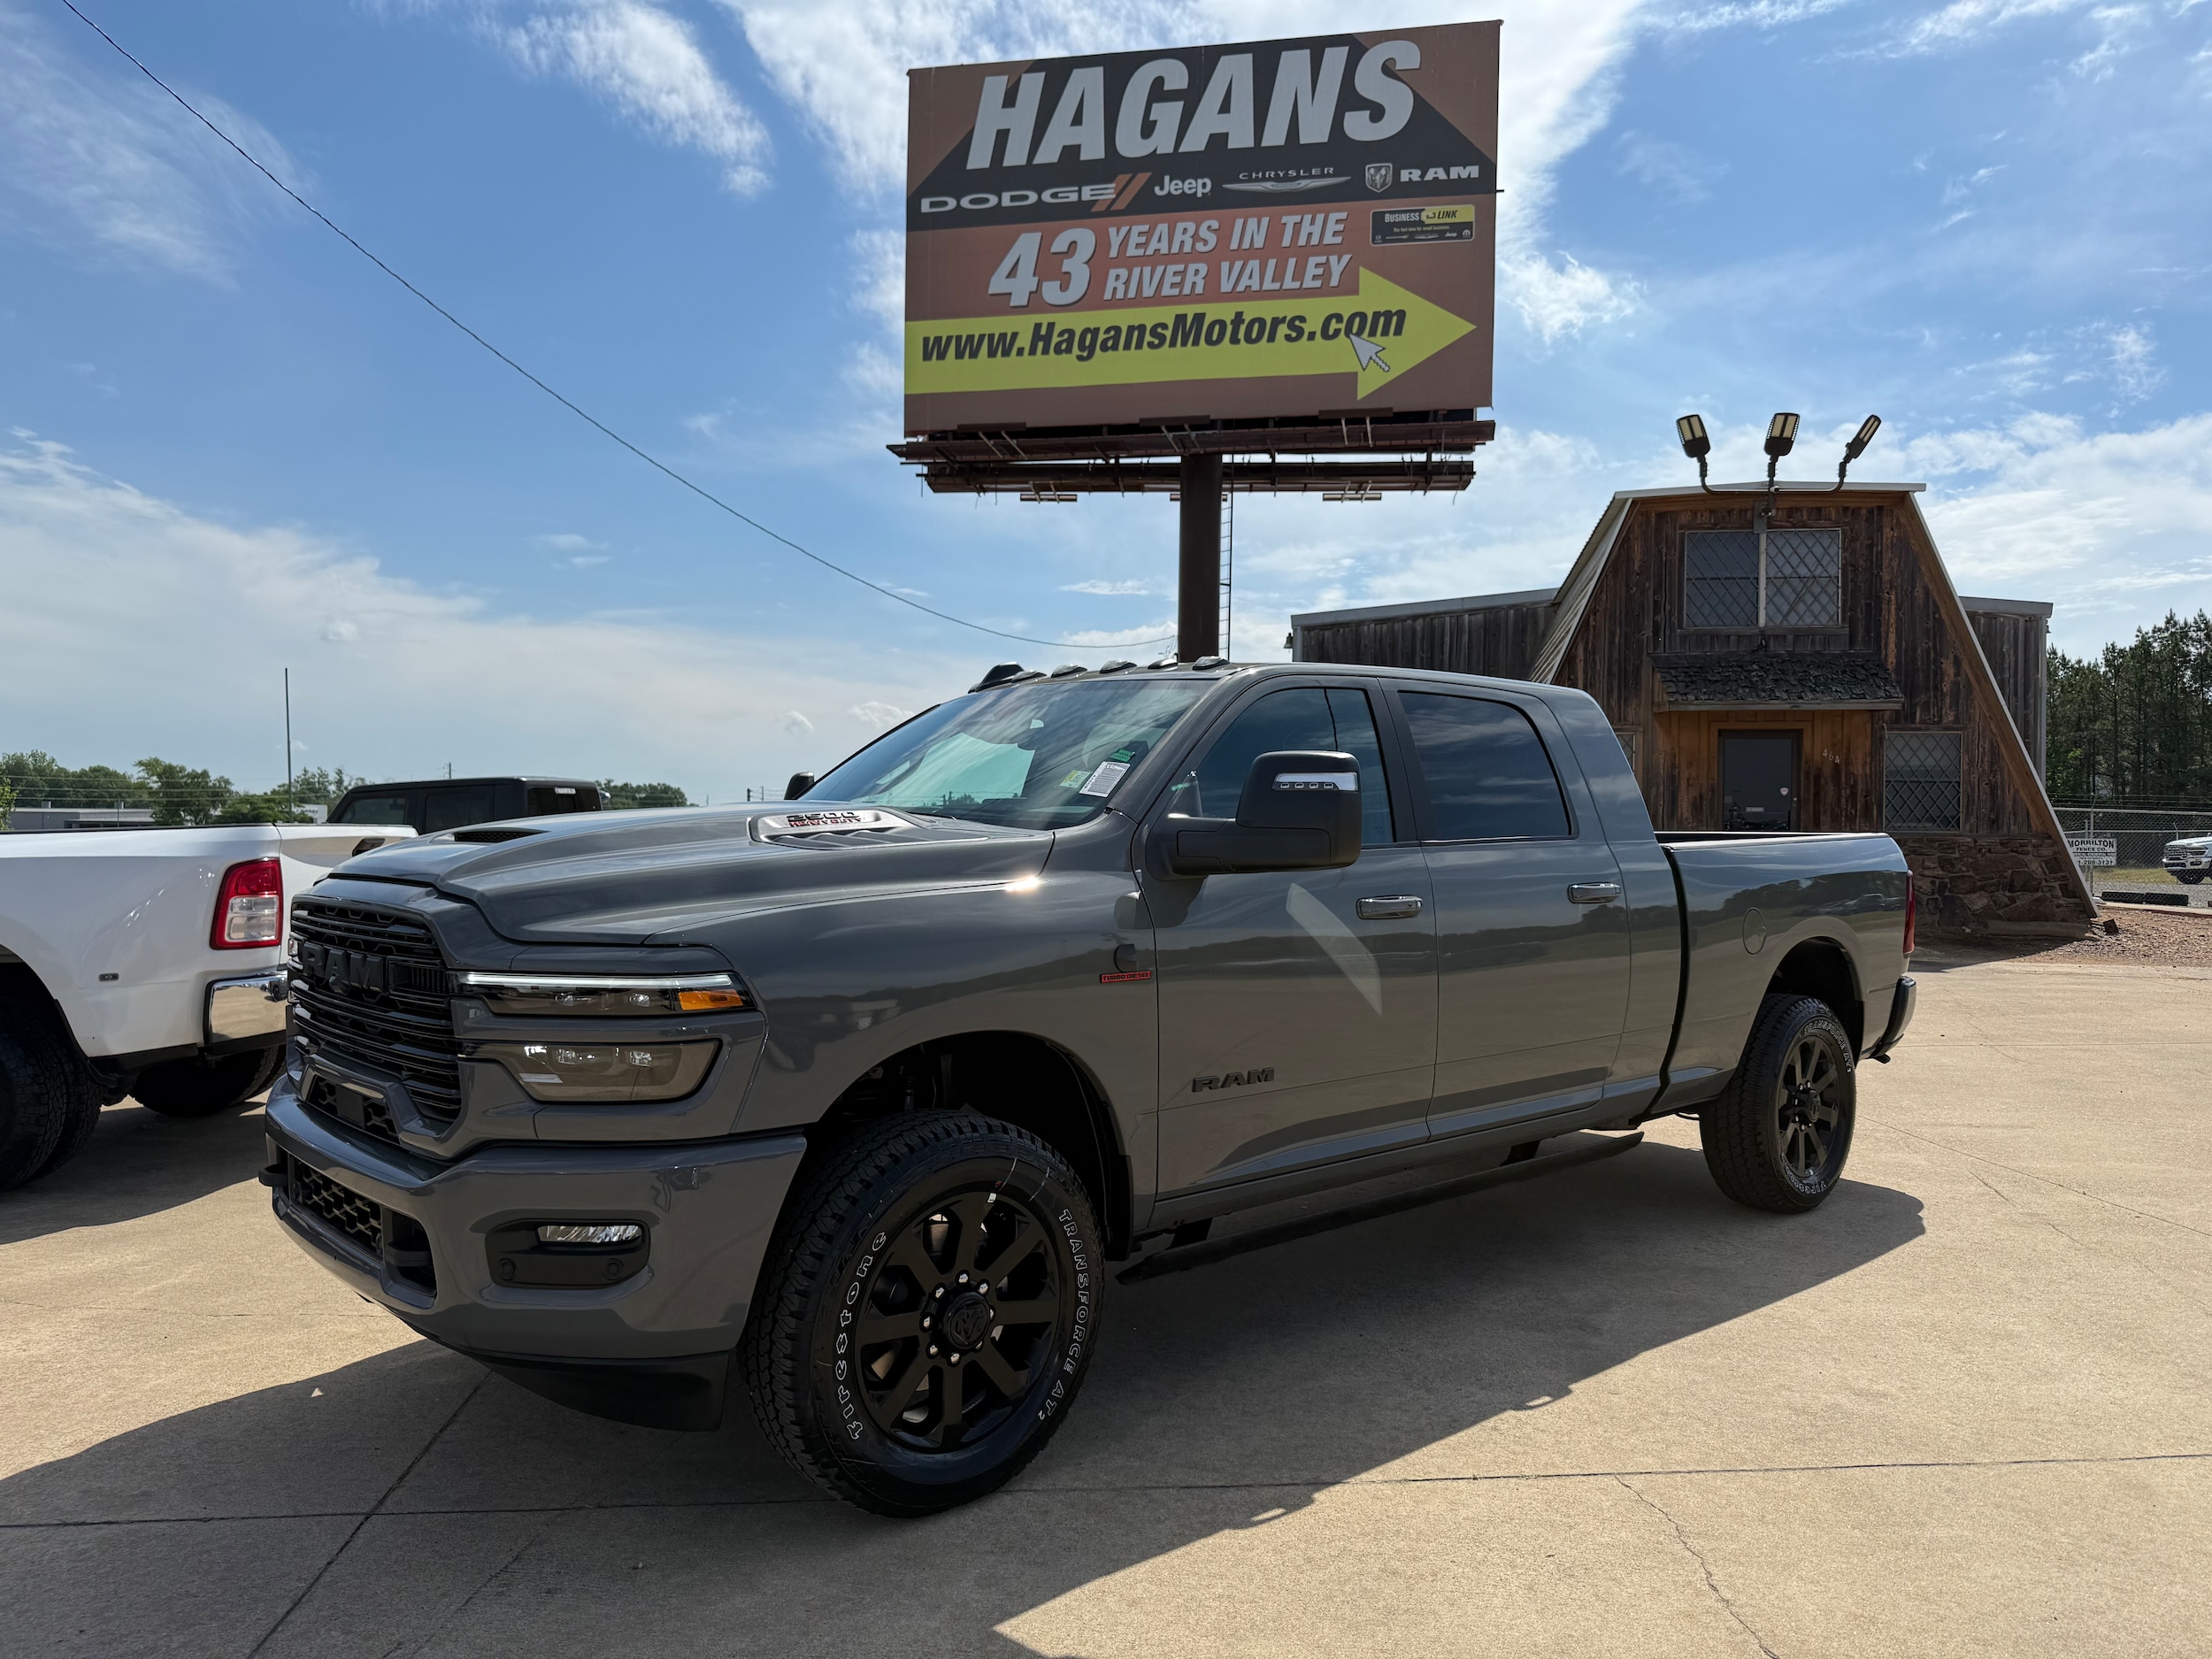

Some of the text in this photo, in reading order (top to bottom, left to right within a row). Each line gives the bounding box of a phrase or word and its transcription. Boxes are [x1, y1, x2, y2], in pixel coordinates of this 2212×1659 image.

[965, 40, 1422, 171] HAGANS
[1154, 175, 1211, 197] Jeep
[1239, 166, 1334, 180] CHRYSLER
[1400, 165, 1479, 182] RAM
[920, 182, 1116, 213] DODGE
[1384, 210, 1458, 223] BUSINESS LINK
[1108, 211, 1348, 258] YEARS IN THE
[987, 227, 1097, 308] 43
[1103, 254, 1352, 301] RIVER VALLEY
[922, 309, 1407, 363] www.HagansMotors.com
[302, 941, 384, 994] RAM
[1192, 1067, 1275, 1093] RAM
[1057, 1208, 1090, 1375] TRANSFORCE
[834, 1231, 887, 1440] Firestone
